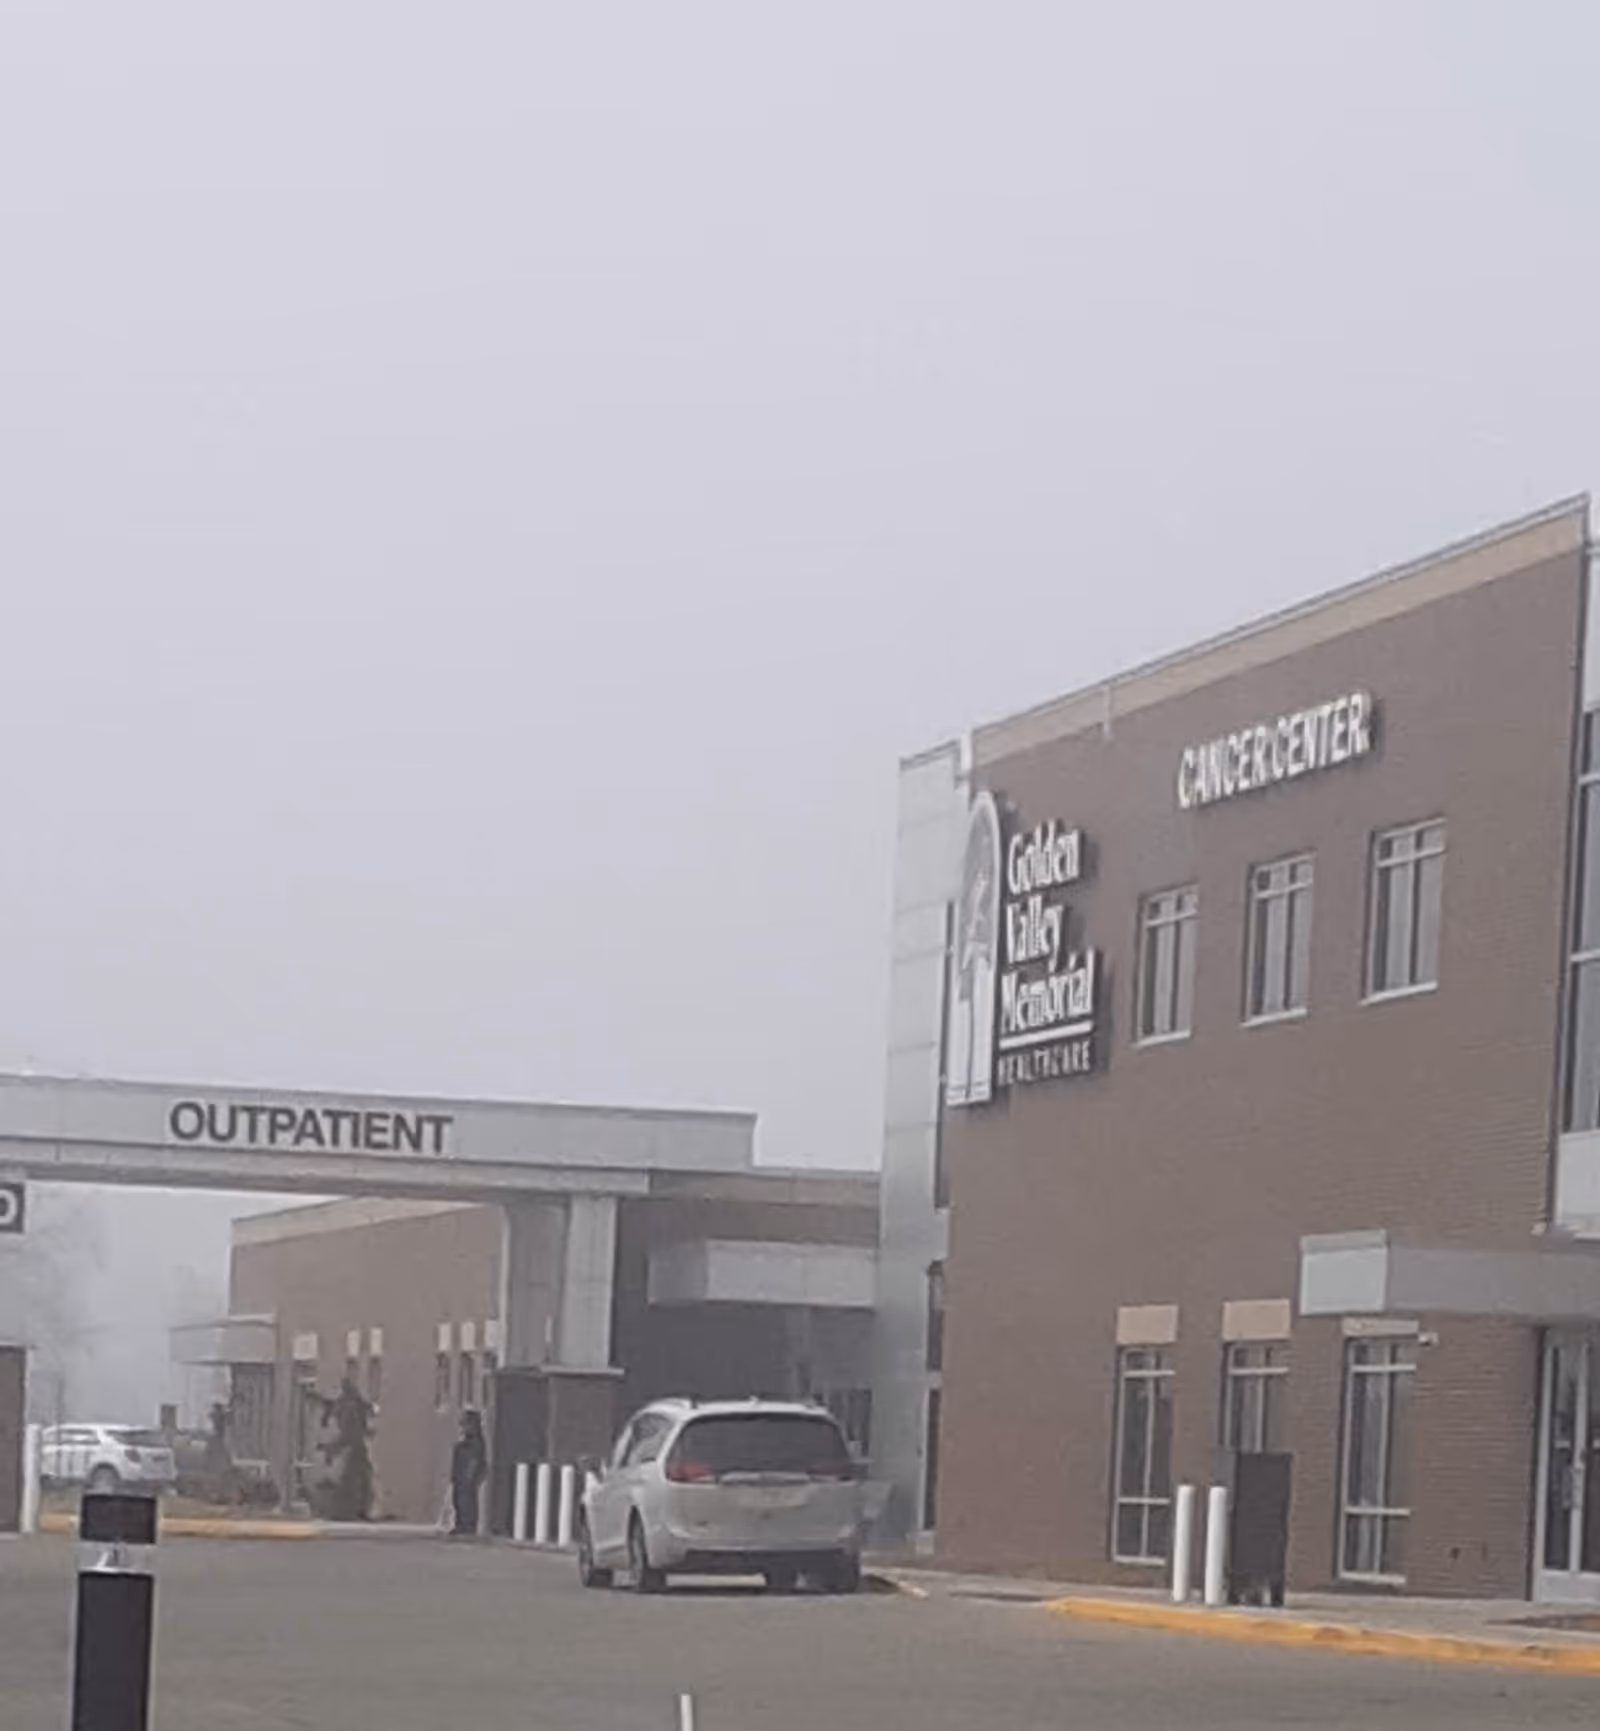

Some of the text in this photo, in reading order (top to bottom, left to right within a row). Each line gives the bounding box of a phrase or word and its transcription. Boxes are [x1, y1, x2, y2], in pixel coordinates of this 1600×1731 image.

[1178, 692, 1371, 808] CANCER CENTER
[1008, 820, 1080, 894] Golden
[1007, 895, 1064, 973] Valley
[1001, 947, 1094, 1034] Memorial
[998, 1041, 1090, 1087] HEALTHCARE
[169, 1101, 453, 1155] OUTPATIENT
